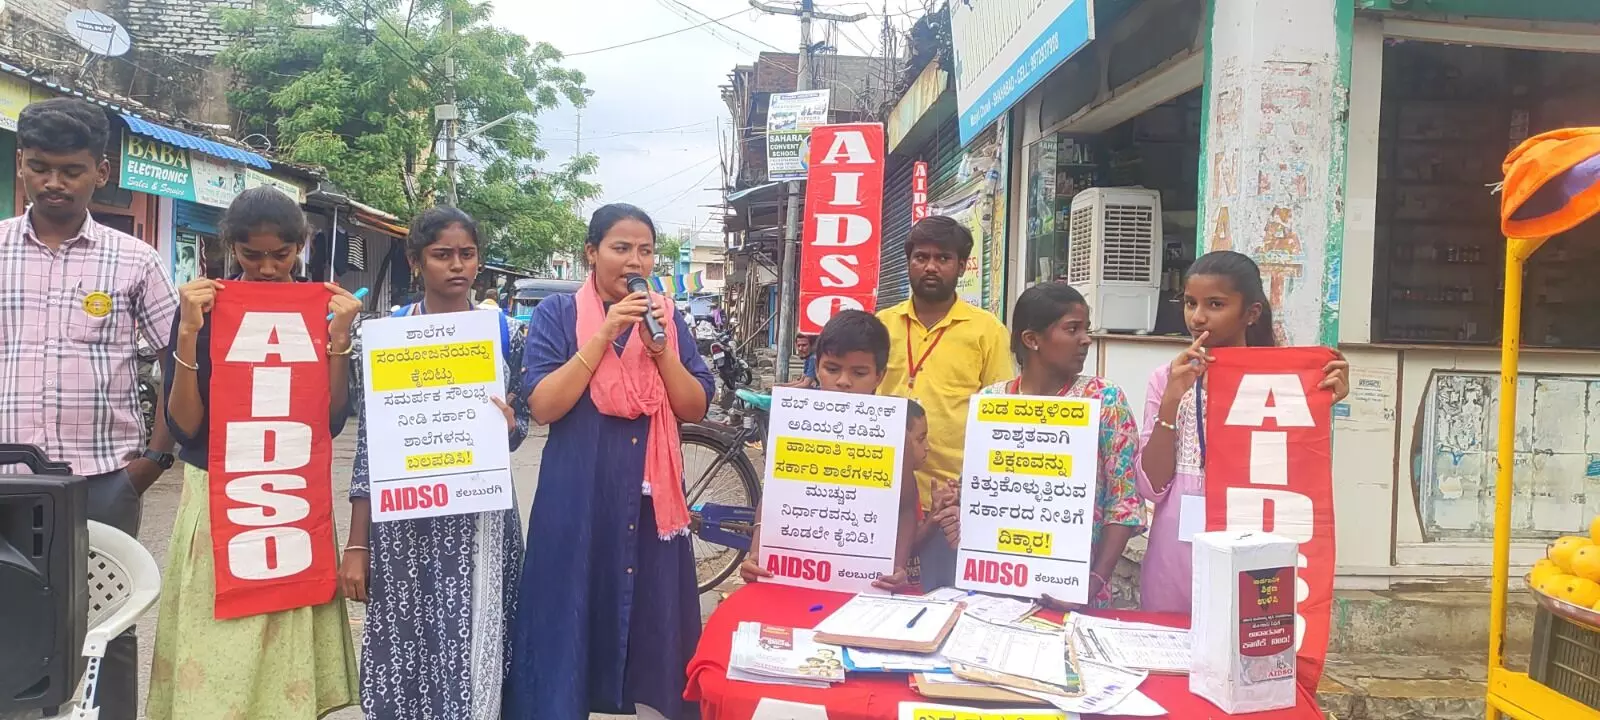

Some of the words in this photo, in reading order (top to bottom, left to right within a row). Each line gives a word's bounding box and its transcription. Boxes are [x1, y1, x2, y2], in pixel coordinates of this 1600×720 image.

[769, 134, 803, 142] SAHARA
[127, 135, 189, 170] BABA
[127, 160, 188, 185] ELECTRONICS
[127, 176, 149, 189] Sales
[150, 180, 158, 190] &
[160, 182, 185, 196] Service
[913, 164, 927, 225] AIDS
[406, 324, 456, 340] ಶಾಲೆಗಳ
[376, 344, 491, 363] ಸಂಯೋಜನೆಯನ್ನು
[411, 367, 455, 387] ಕೈಬಿಟ್ಟು
[384, 389, 441, 406] ಸಮರ್ಪಕ
[446, 385, 489, 403] ಸೌಲಭ್ಯ
[397, 412, 427, 428] ನೀಡಿ
[432, 408, 476, 424] ಸರ್ಕಾರಿ
[781, 396, 809, 410] ಹಬ್
[813, 400, 851, 413] ಅಂಡ್
[854, 401, 896, 422] ಸ್ಪೋಕ್
[982, 401, 1009, 415] ಬಡ
[1014, 403, 1085, 423] ಮಕ್ಕಳಿಂದ
[404, 430, 474, 448] ಶಾಲೆಗಳನ್ನು
[788, 419, 845, 440] ಅಡಿಯಲ್ಲಿ
[848, 423, 886, 438] ಕಡಿಮೆ
[992, 428, 1070, 448] ಶಾಶ್ವತವಾಗಿ
[225, 311, 319, 580] AIDSO
[786, 441, 842, 456] ಹಾಜರಾತಿ
[846, 446, 884, 460] ಇರುವ
[407, 450, 471, 469] ಬಲಪಡಿಸಿ!
[992, 451, 1067, 477] ಶಿಕ್ಷಣವನ್ನು
[775, 460, 819, 475] ಸರ್ಕಾರಿ
[823, 465, 891, 488] ಶಾಲೆಗಳನ್ನು
[380, 483, 449, 513] AIDSO
[455, 484, 503, 498] ಕಲಬುರಗಿ
[805, 484, 857, 505] ಮುಚ್ಚುವ
[971, 475, 1087, 502] ಕಿತ್ತುಕೊಳ್ಳುತ್ತಿರುವ
[781, 504, 860, 527] ನಿರ್ಧಾರವನ್ನು
[863, 510, 878, 524] ಈ
[969, 501, 1035, 521] ಸರ್ಕಾರದ
[1040, 507, 1085, 525] ನೀತಿಗೆ
[781, 524, 830, 540] ಕೂಡಲೇ
[834, 528, 875, 548] ಕೈಬಿಡಿ!
[998, 530, 1050, 553] ದಿಕ್ಕಾರ!
[767, 553, 831, 582] AIDSO
[963, 558, 1028, 587] AIDSO
[1034, 572, 1080, 586] ಕಲಬುರಗಿ
[1267, 668, 1293, 678] AIDSO
